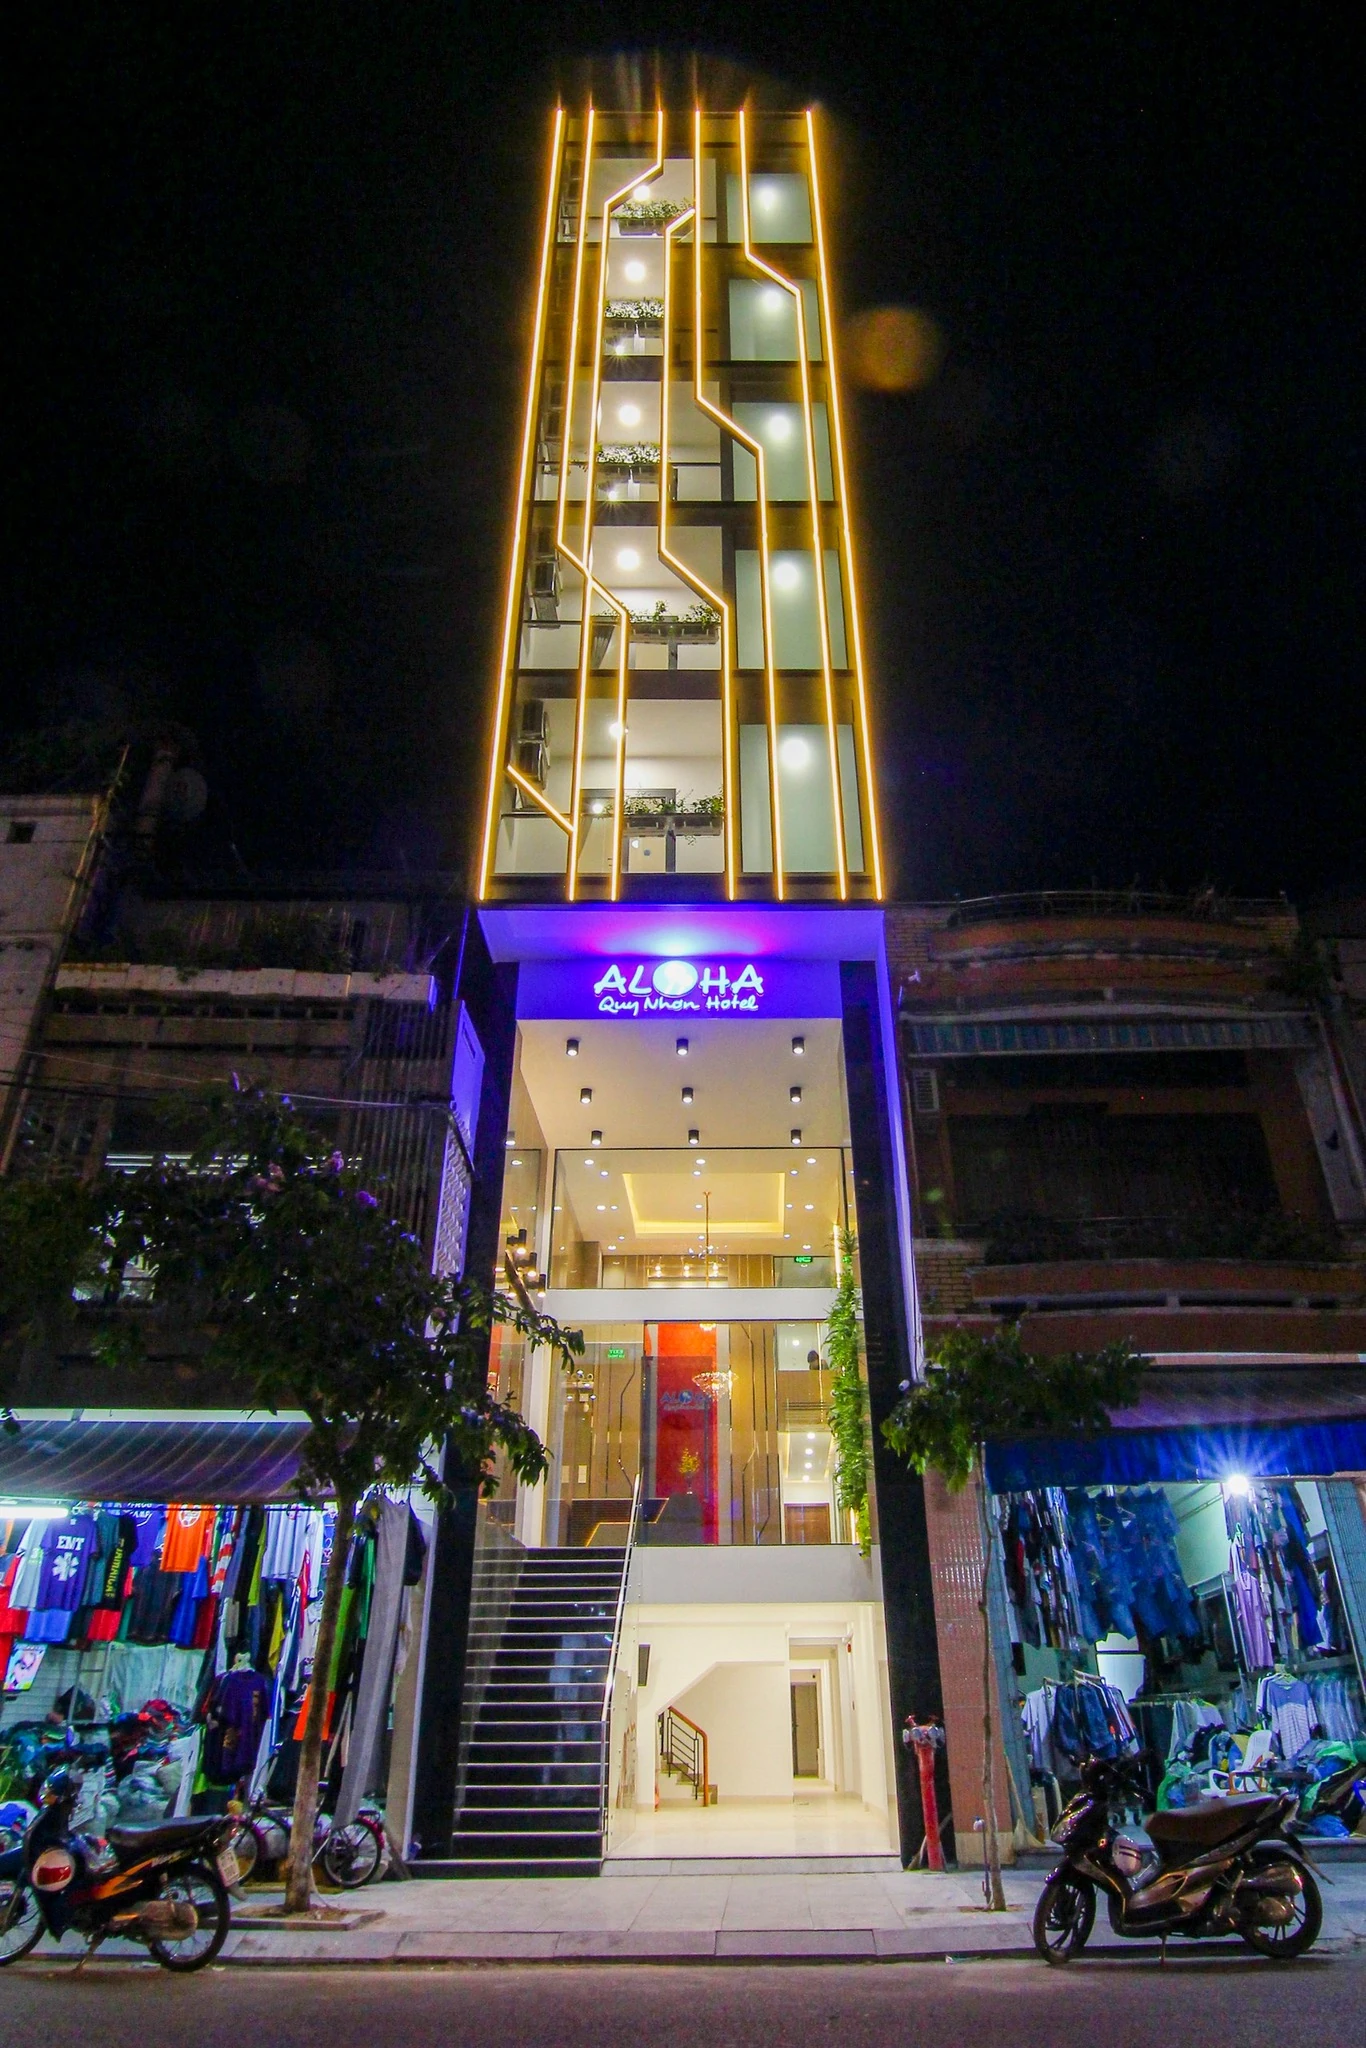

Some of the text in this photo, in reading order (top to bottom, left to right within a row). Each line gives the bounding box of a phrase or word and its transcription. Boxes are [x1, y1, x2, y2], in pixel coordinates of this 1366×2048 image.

[594, 960, 764, 997] ALOHA
[598, 996, 639, 1016] Quy
[705, 994, 759, 1011] Hotel
